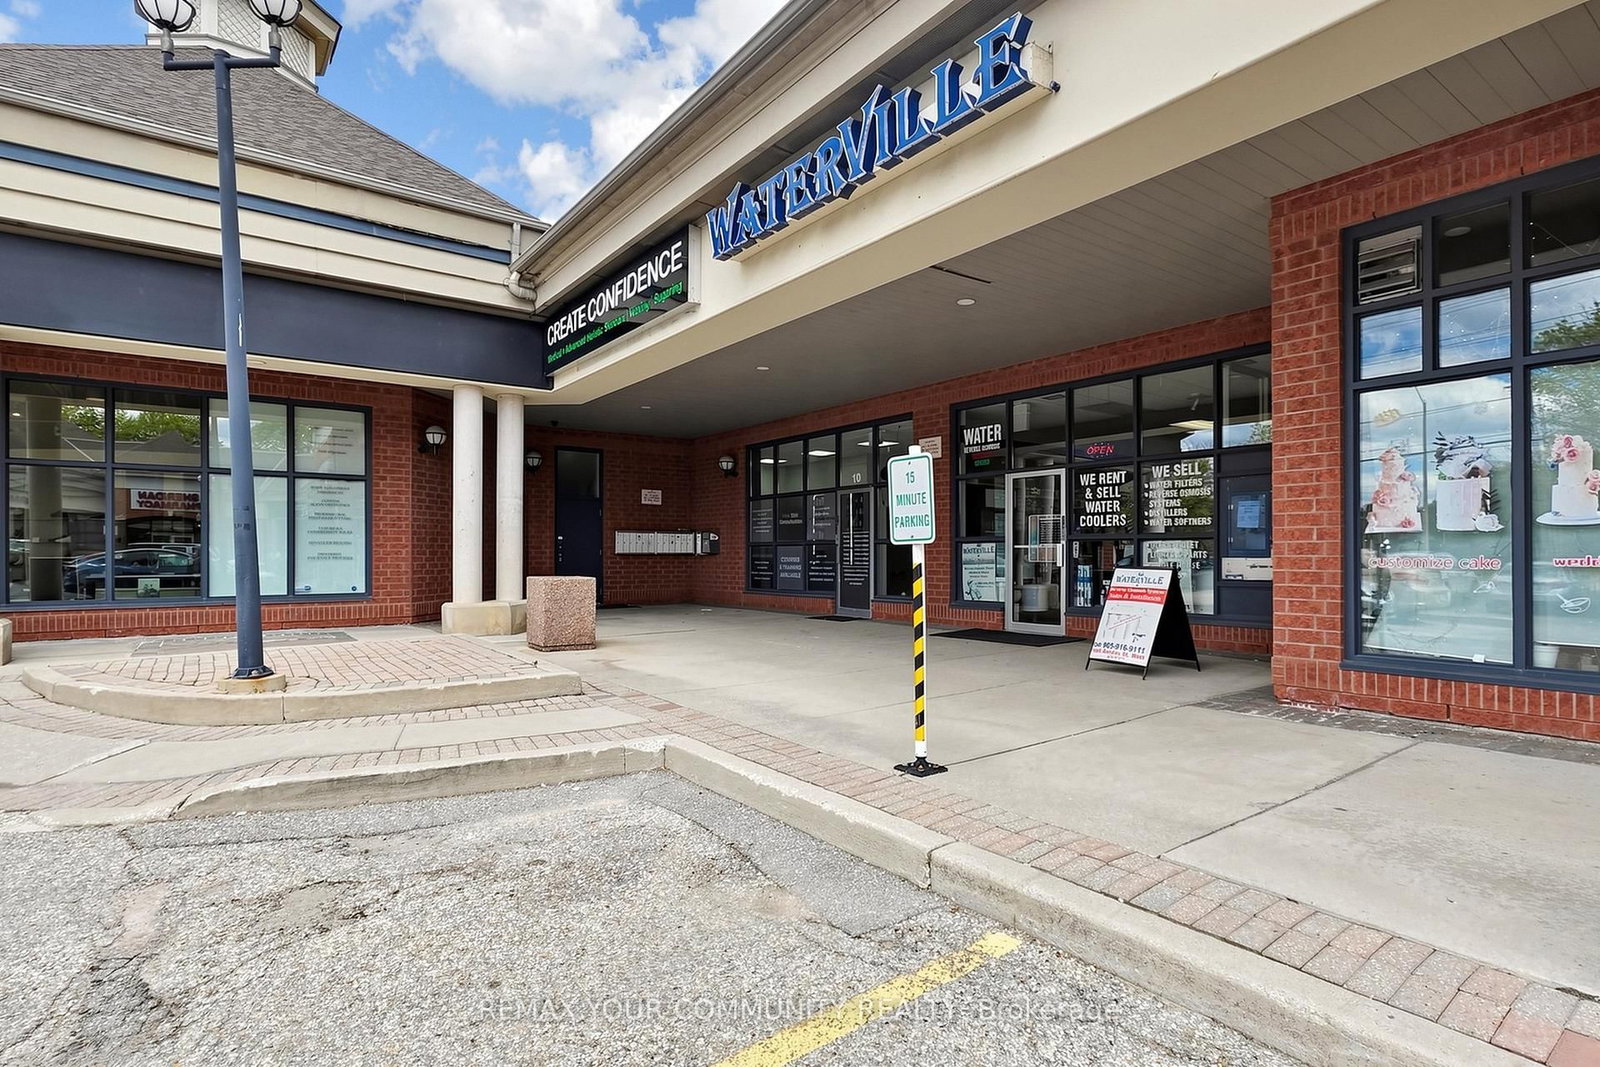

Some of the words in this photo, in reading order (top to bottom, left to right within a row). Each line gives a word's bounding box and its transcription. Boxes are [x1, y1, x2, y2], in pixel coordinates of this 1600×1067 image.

[705, 11, 1034, 261] WATERVILLE
[547, 304, 587, 346] CREATE
[587, 240, 683, 322] CONFIDENCE
[654, 281, 683, 304] Sugaring
[963, 424, 1002, 446] WATER
[1086, 444, 1114, 456] OPEN
[1152, 464, 1170, 478] WE
[1173, 462, 1202, 477] SELL
[852, 472, 861, 483] 10
[905, 471, 915, 484] 15
[1080, 473, 1096, 486] WE
[1099, 471, 1127, 484] RENT
[1149, 480, 1172, 489] WATER
[1174, 478, 1203, 488] FILTERS
[1085, 488, 1093, 499] &
[1096, 485, 1121, 498] SELL
[1149, 488, 1178, 498] REVERSE
[1179, 487, 1211, 497] OSMOSIS
[896, 492, 927, 507] MINUTE
[1149, 498, 1181, 508] SYSTEMS
[1085, 500, 1120, 513] WATER
[1149, 508, 1188, 517] DISTILLERS
[895, 514, 930, 528] PARKING
[1080, 514, 1127, 527] COOLERS
[1149, 517, 1172, 527] WATER
[1174, 516, 1212, 526] SOFTNERS
[1368, 556, 1453, 569] customize
[1458, 555, 1502, 570] cake
[1115, 574, 1165, 585] WATERVILLE
